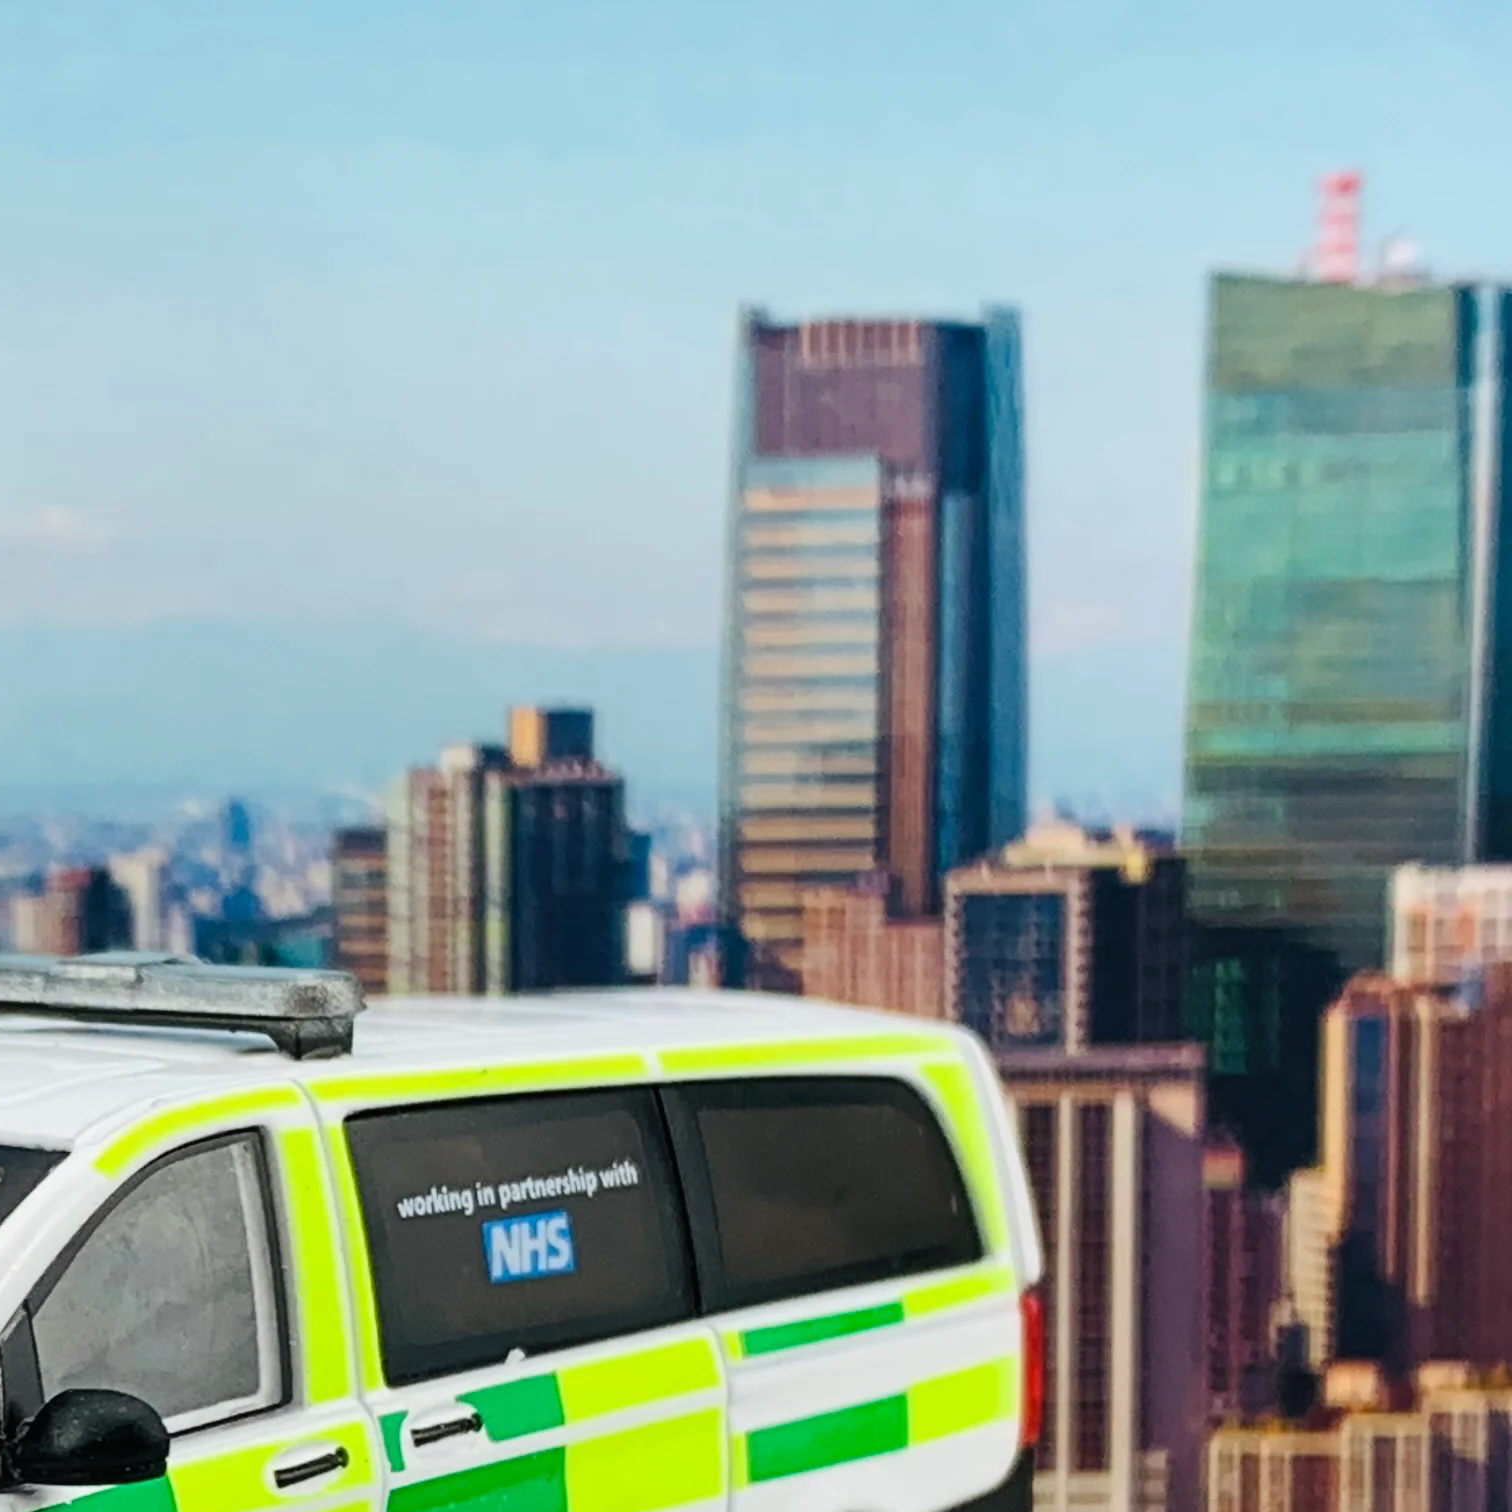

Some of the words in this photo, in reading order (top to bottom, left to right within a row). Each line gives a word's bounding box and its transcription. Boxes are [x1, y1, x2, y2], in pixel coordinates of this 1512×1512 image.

[397, 1187, 473, 1219] working
[475, 1183, 496, 1207] in
[498, 1167, 598, 1210] partnership
[599, 1157, 639, 1188] with
[489, 1212, 573, 1281] NHS
